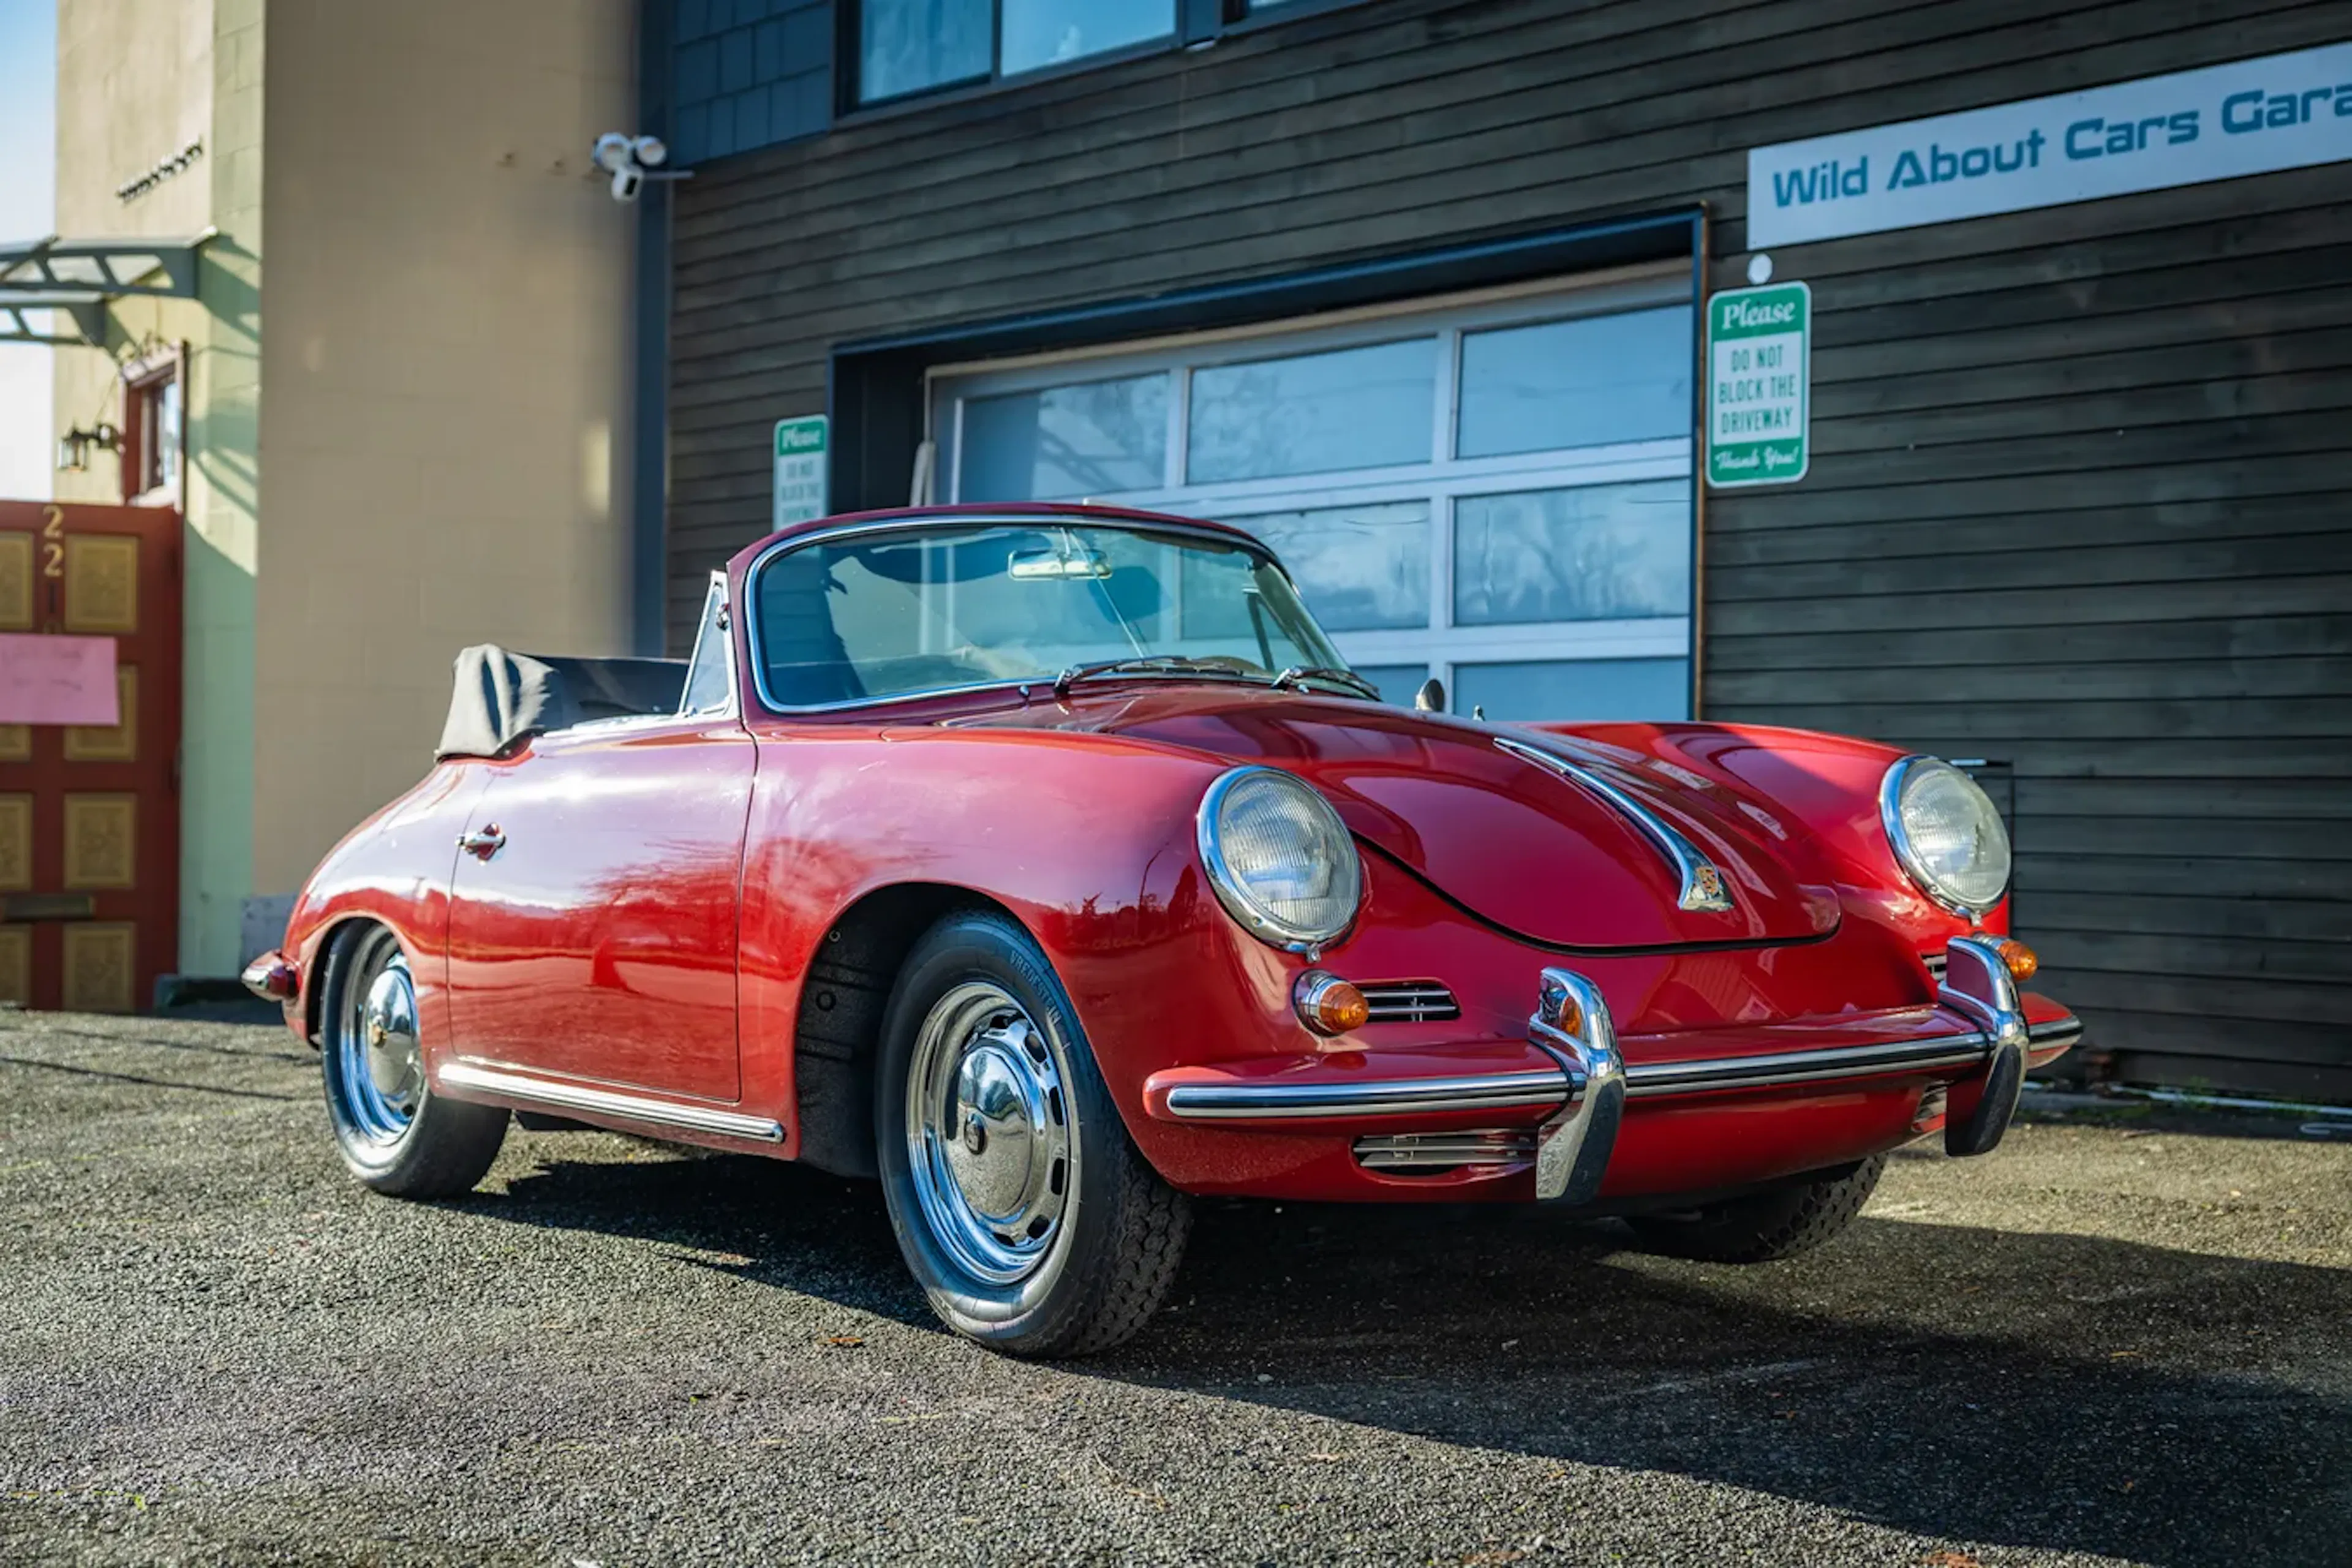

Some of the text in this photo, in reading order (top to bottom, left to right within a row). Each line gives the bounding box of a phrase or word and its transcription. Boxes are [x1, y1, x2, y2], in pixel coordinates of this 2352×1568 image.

[1773, 154, 1869, 207] Wild
[1887, 128, 2046, 190] About
[2064, 110, 2200, 160] Cars
[1721, 298, 1796, 330] Please
[1731, 343, 1783, 372] DO NOT
[1719, 374, 1796, 404] BLOCK THE
[1721, 406, 1793, 434] DRIVEWAY
